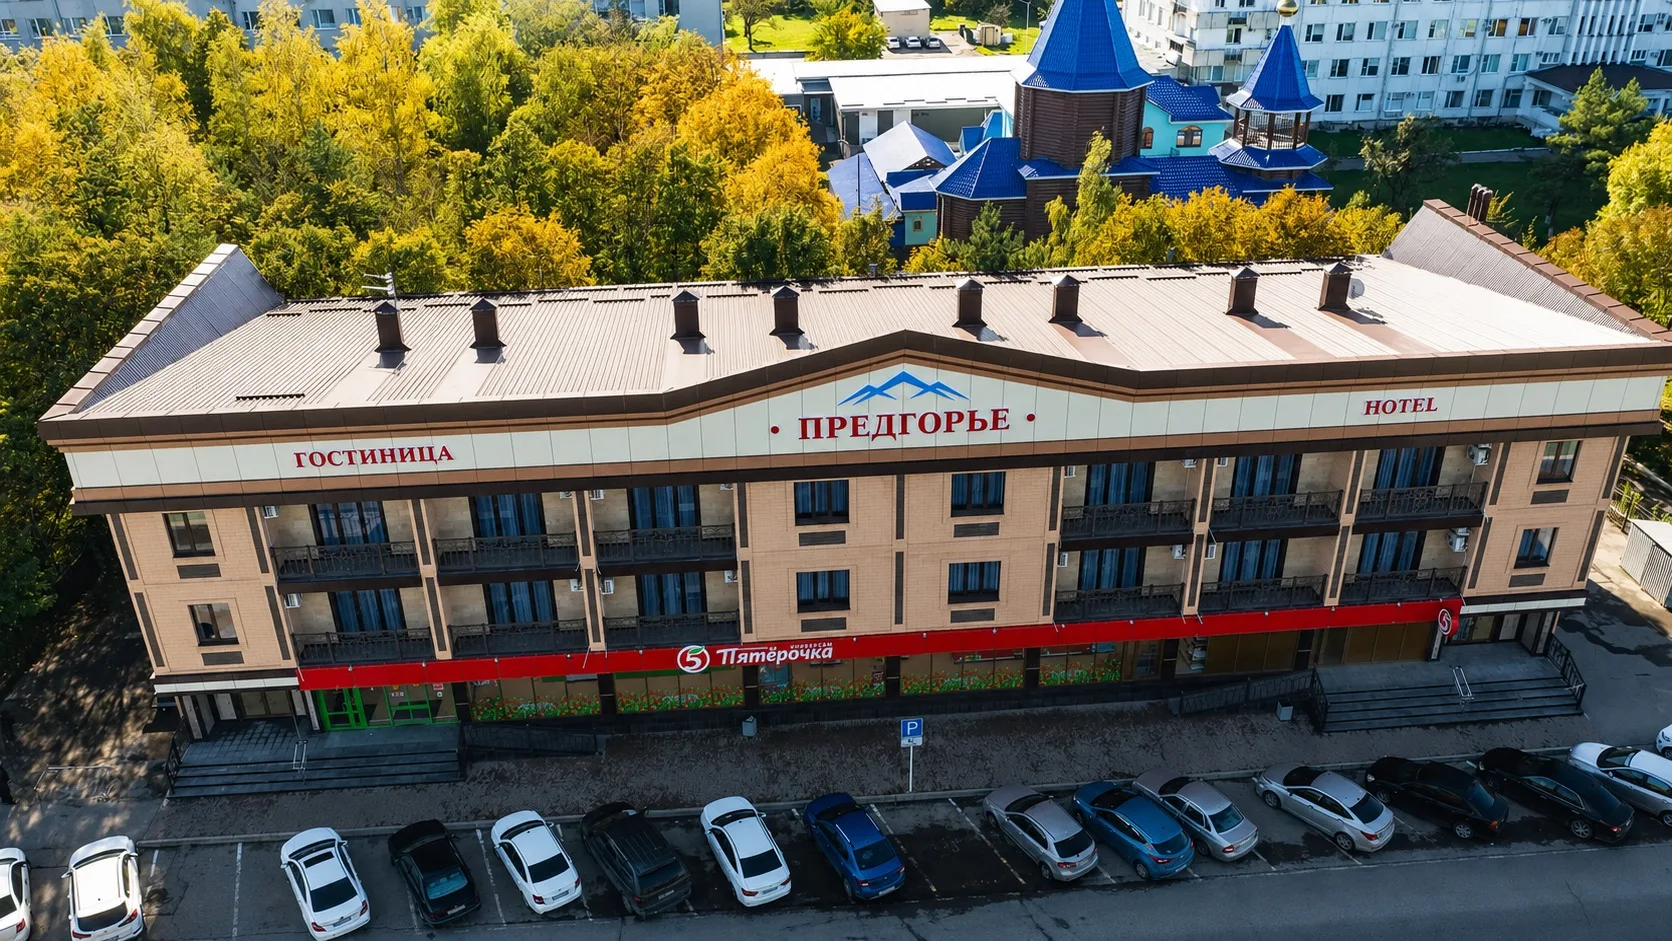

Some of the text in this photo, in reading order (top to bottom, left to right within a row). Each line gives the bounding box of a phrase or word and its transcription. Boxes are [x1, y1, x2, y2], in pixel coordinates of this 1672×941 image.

[1364, 397, 1438, 416] HOTEL
[798, 408, 1010, 441] ПРЕДГОРЬЕ
[293, 445, 454, 468] ГОСТИНИЦА
[684, 645, 833, 670] 5 Пятёрочка
